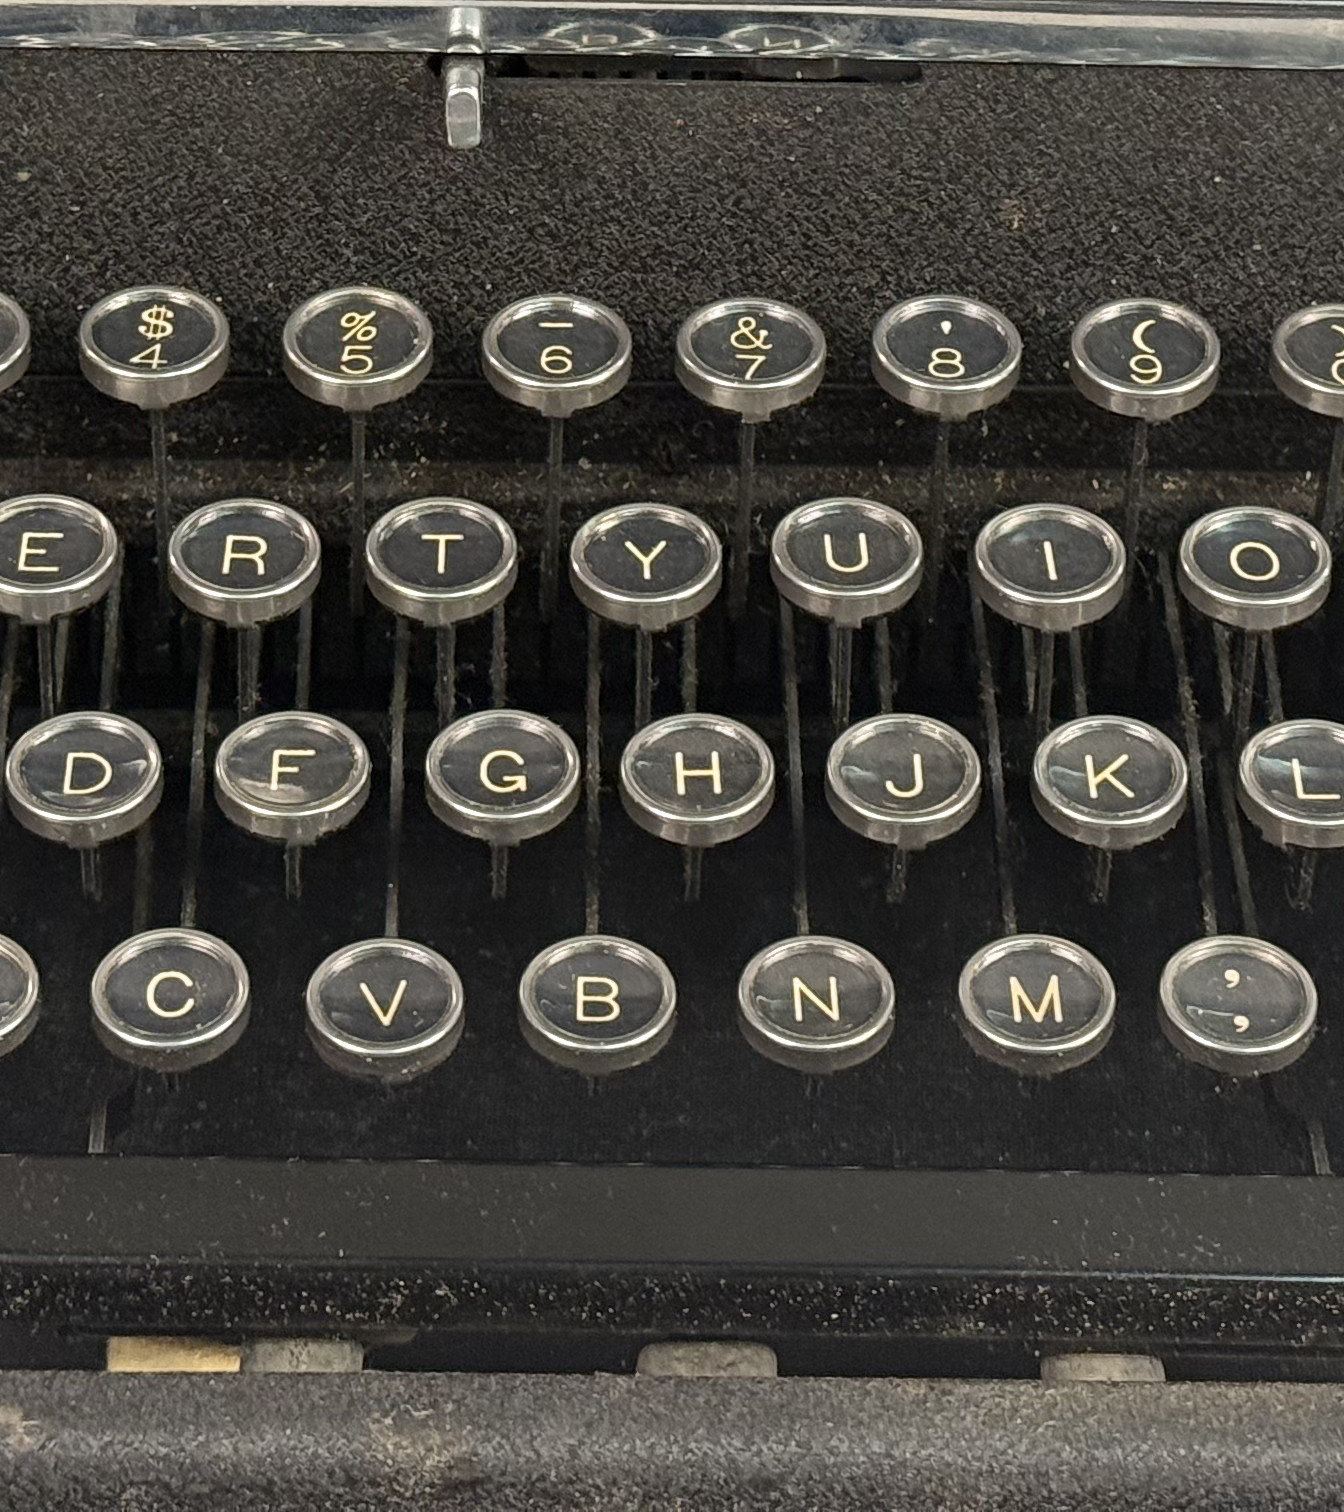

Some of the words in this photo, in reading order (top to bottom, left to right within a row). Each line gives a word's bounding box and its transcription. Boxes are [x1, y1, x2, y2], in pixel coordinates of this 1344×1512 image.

[137, 303, 175, 341] $
[340, 310, 377, 342] %
[729, 315, 774, 350] &
[129, 343, 168, 370] 4
[339, 345, 373, 377] 5
[540, 345, 573, 374] 6
[735, 354, 767, 381] 7
[927, 347, 966, 379] 8
[1129, 351, 1163, 385] 9
[17, 531, 64, 572] E
[222, 534, 268, 575] R
[421, 533, 464, 574] T
[624, 540, 667, 580] Y
[823, 532, 869, 573] U
[1043, 540, 1058, 581] I
[1229, 541, 1280, 581] O
[62, 751, 113, 795] D
[269, 749, 316, 791] F
[479, 749, 527, 793] G
[674, 750, 722, 796] H
[885, 753, 924, 798] J
[1084, 753, 1135, 799] K
[1289, 758, 1341, 800] L
[146, 970, 195, 1018] C
[359, 979, 408, 1026] V
[575, 976, 620, 1022] B
[792, 976, 840, 1022] N
[1009, 974, 1063, 1023] M
